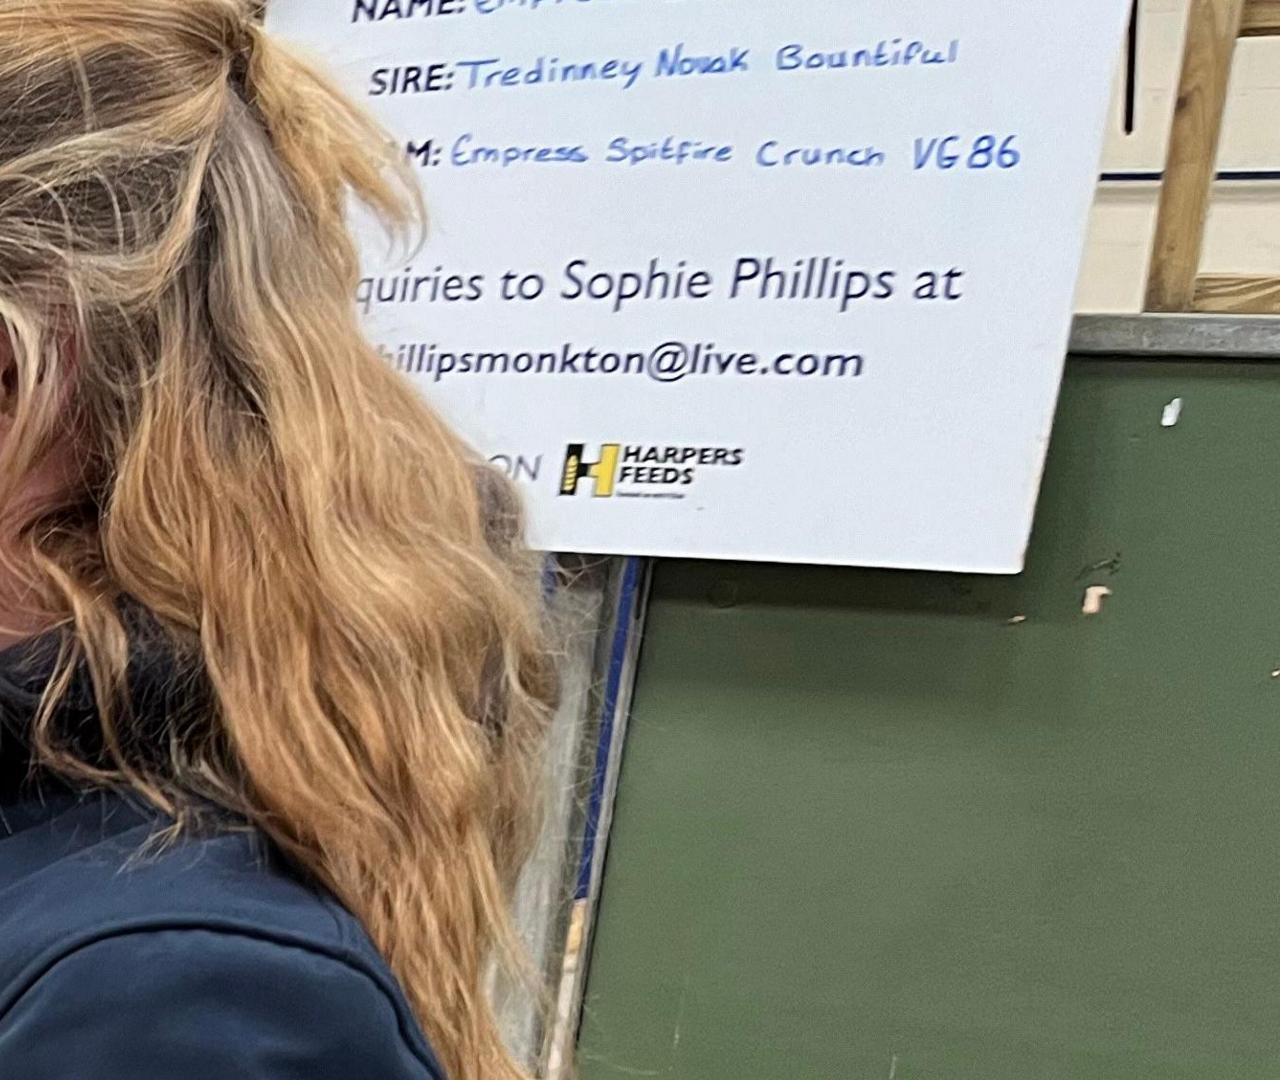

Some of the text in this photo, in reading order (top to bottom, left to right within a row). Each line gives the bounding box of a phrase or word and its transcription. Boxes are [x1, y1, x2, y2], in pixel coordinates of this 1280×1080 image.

[368, 63, 453, 96] SIRE:
[456, 57, 643, 90] Tredinney
[775, 38, 960, 71] Bountiful
[404, 138, 442, 167] M:
[451, 133, 589, 167] Empress
[606, 131, 734, 166] Spitfire
[755, 140, 886, 167] Crunch
[356, 256, 966, 315] quiries to Sophie Phillips at
[377, 341, 864, 383] illipsmonkton@live.com
[621, 445, 745, 466] HARPERS
[618, 466, 697, 485] FEEDS
